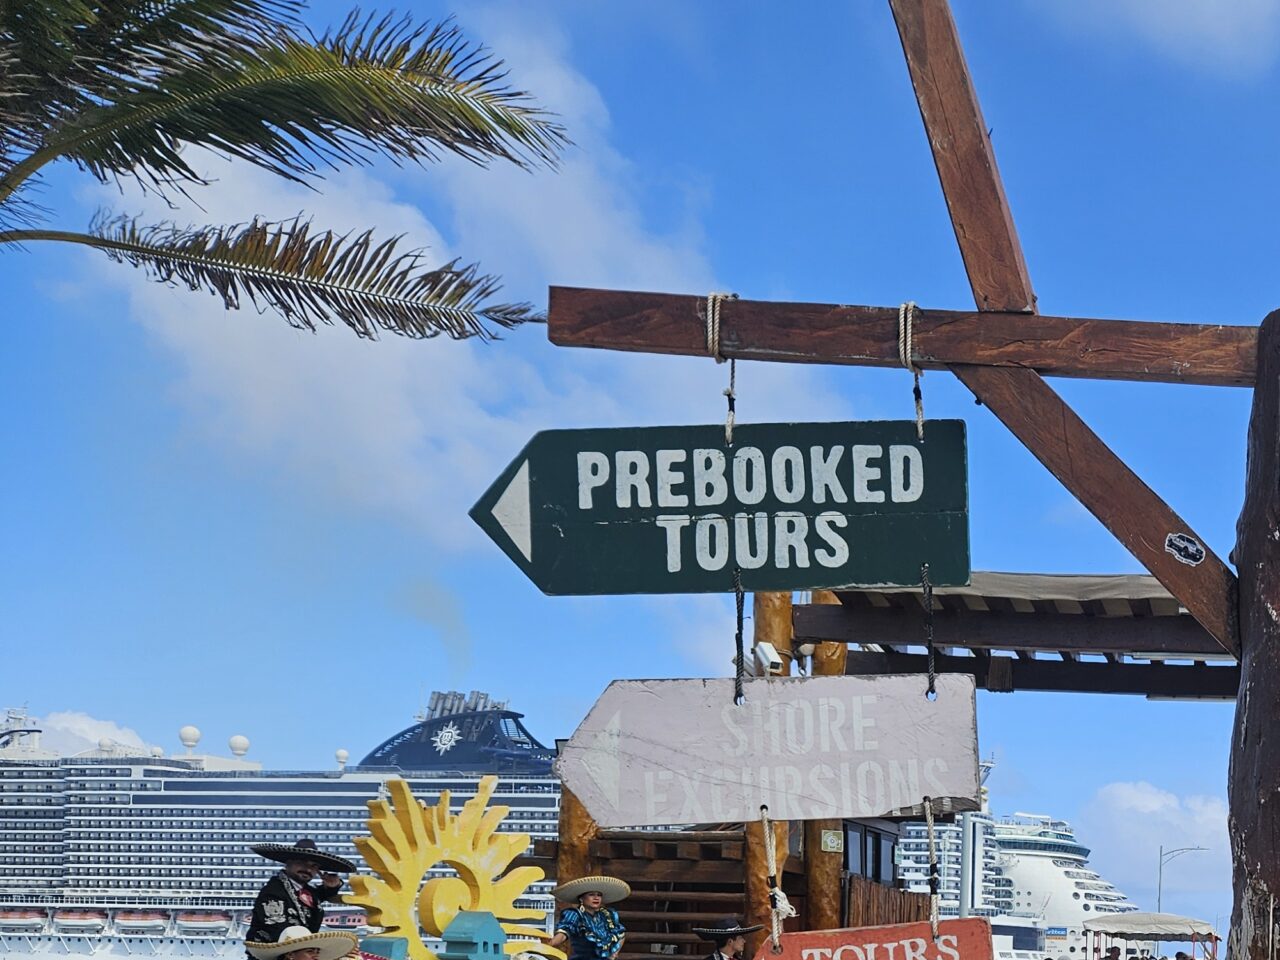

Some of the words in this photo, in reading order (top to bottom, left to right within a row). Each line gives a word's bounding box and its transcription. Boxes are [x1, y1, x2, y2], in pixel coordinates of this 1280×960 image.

[577, 444, 925, 510] PREBOOKED
[655, 511, 850, 573] TOURS
[721, 695, 879, 756] SHORE
[644, 758, 950, 822] EXCURSIONS
